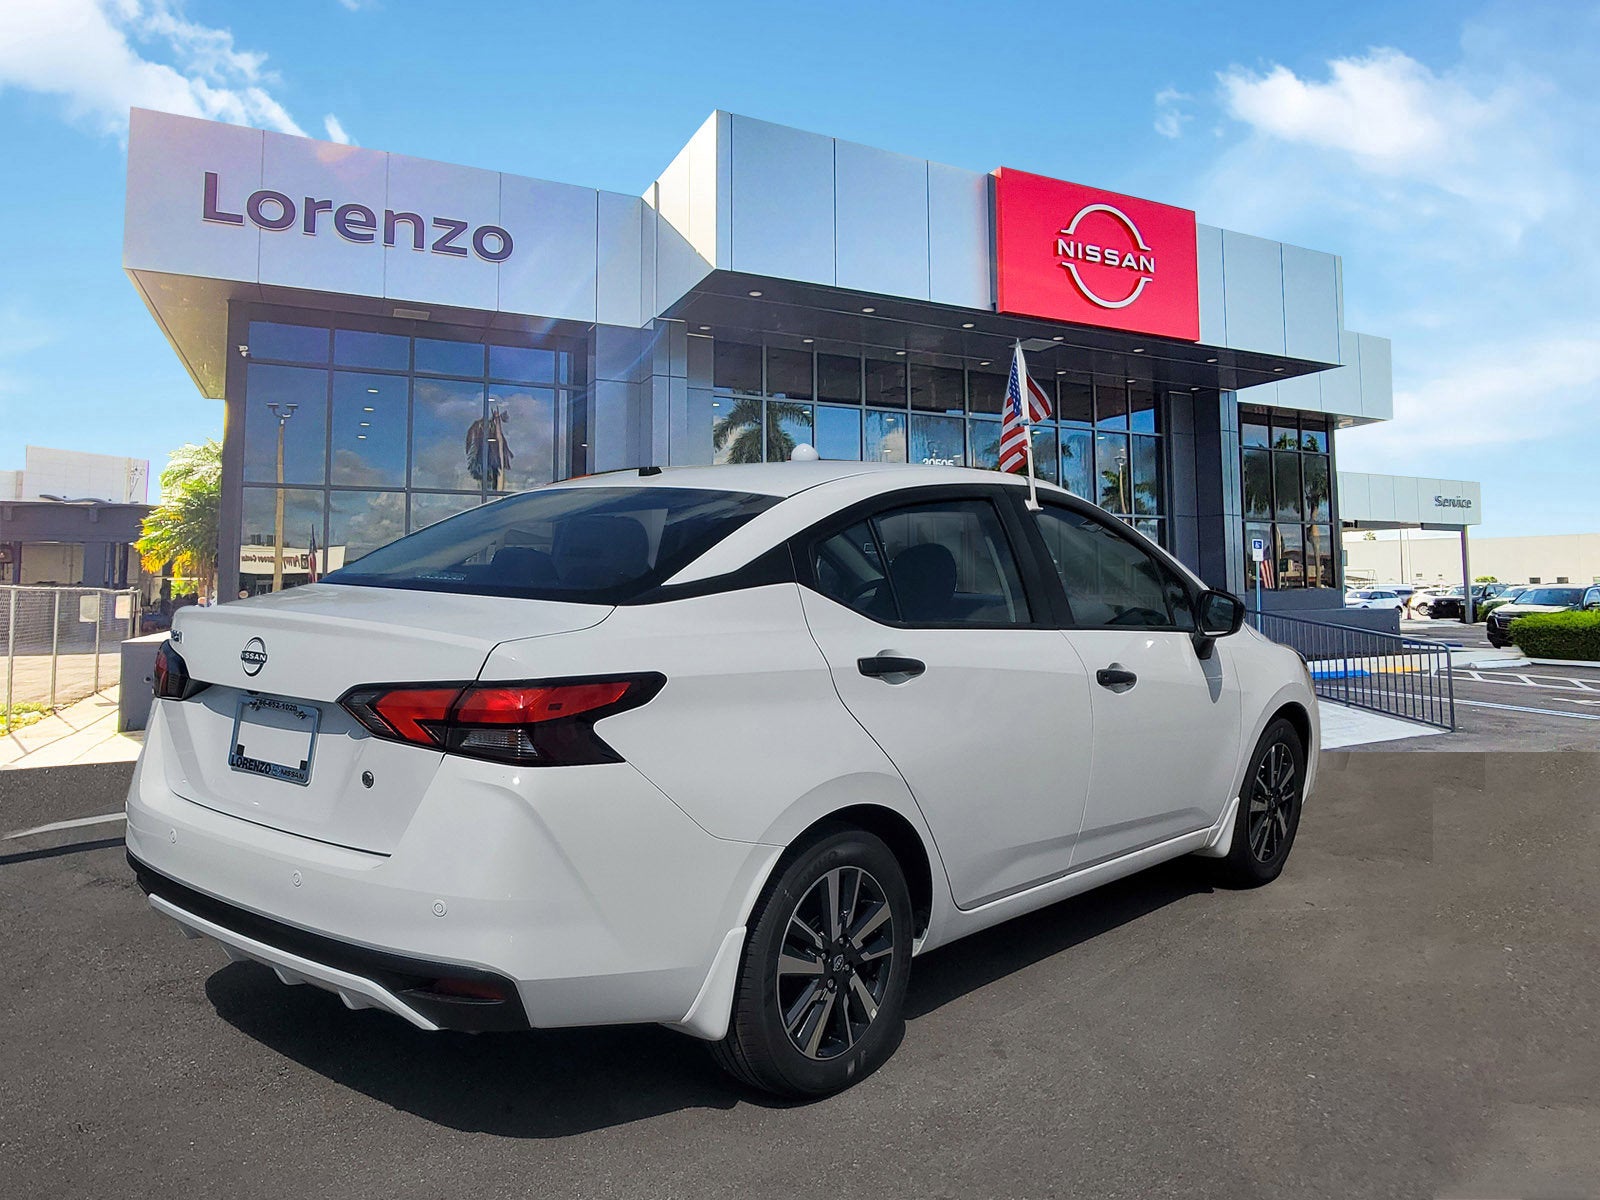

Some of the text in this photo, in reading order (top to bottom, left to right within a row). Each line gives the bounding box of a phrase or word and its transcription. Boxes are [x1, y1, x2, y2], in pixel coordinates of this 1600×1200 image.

[203, 171, 514, 262] Lorenzo
[1057, 238, 1155, 273] NISSAN
[1434, 495, 1472, 509] Service
[231, 754, 305, 780] LORENZO NISSAN
